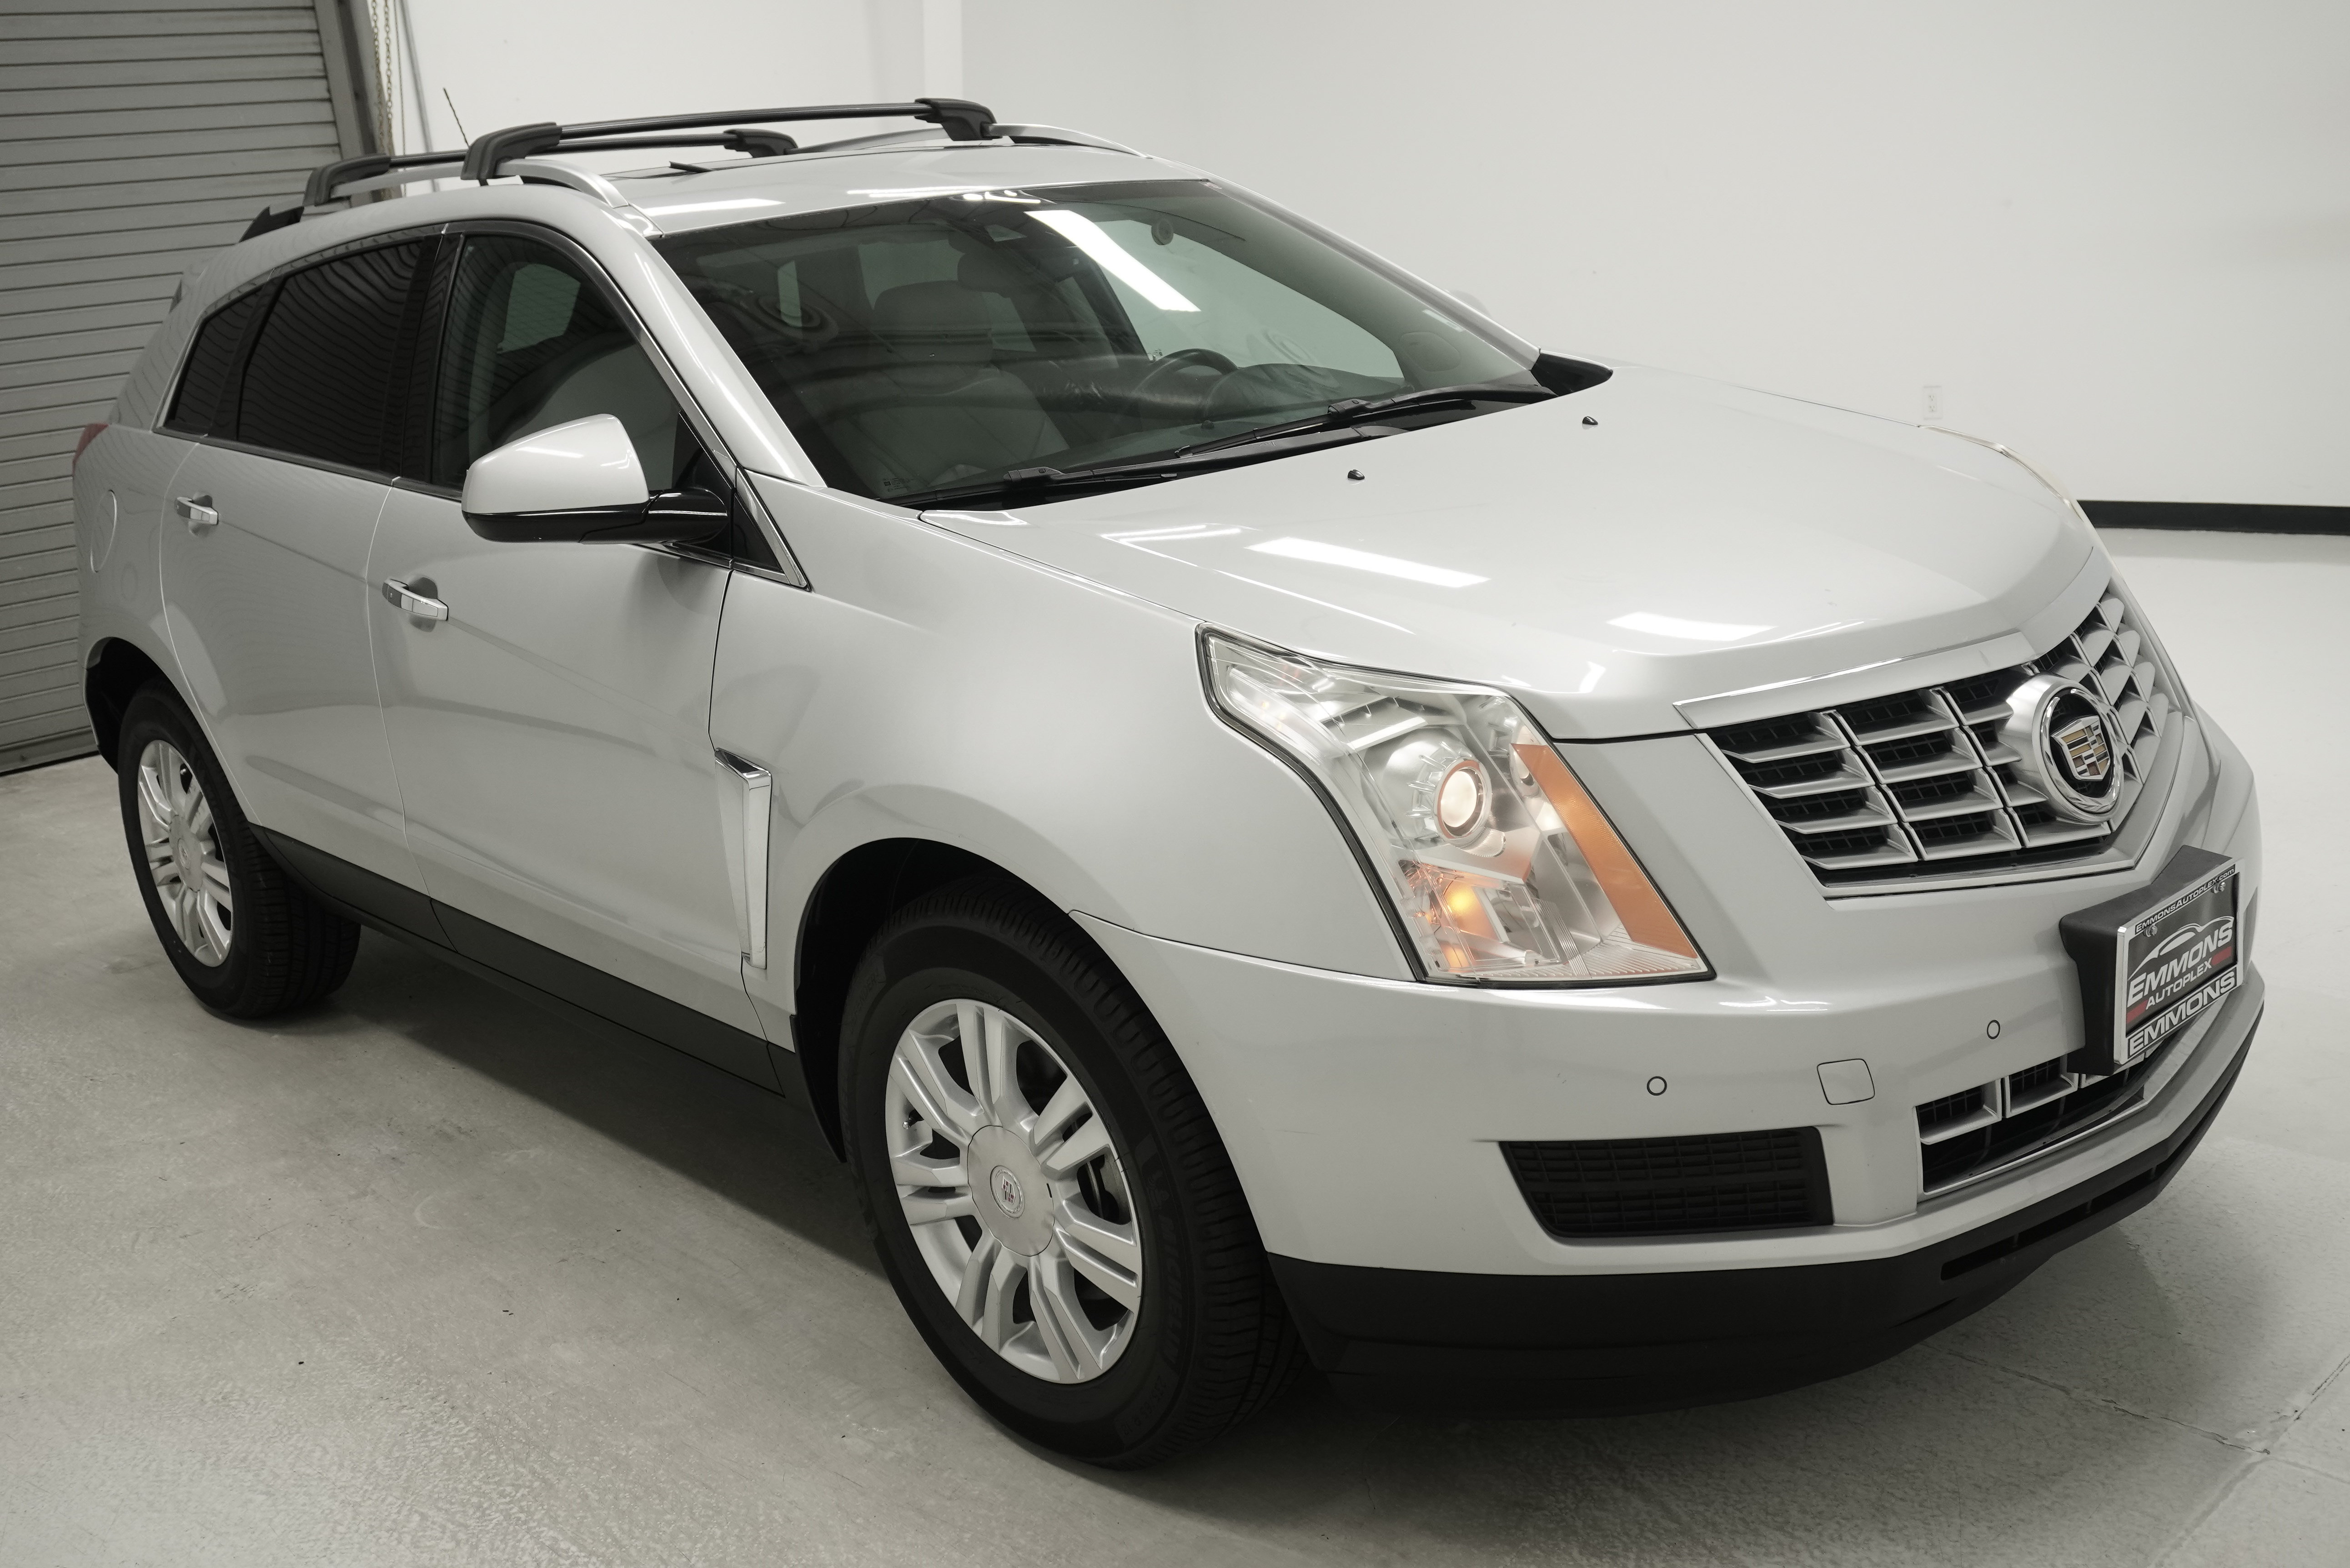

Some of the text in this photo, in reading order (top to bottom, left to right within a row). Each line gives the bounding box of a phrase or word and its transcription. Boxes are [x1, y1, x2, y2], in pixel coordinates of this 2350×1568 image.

[2135, 868, 2235, 933] EMMONSAUTOPLEX.com
[2128, 923, 2233, 1007] EMMONS
[2145, 957, 2213, 1010] AUTOPLEX
[2129, 971, 2236, 1056] EMMONS
[1159, 1215, 1183, 1364] MICHELIN
